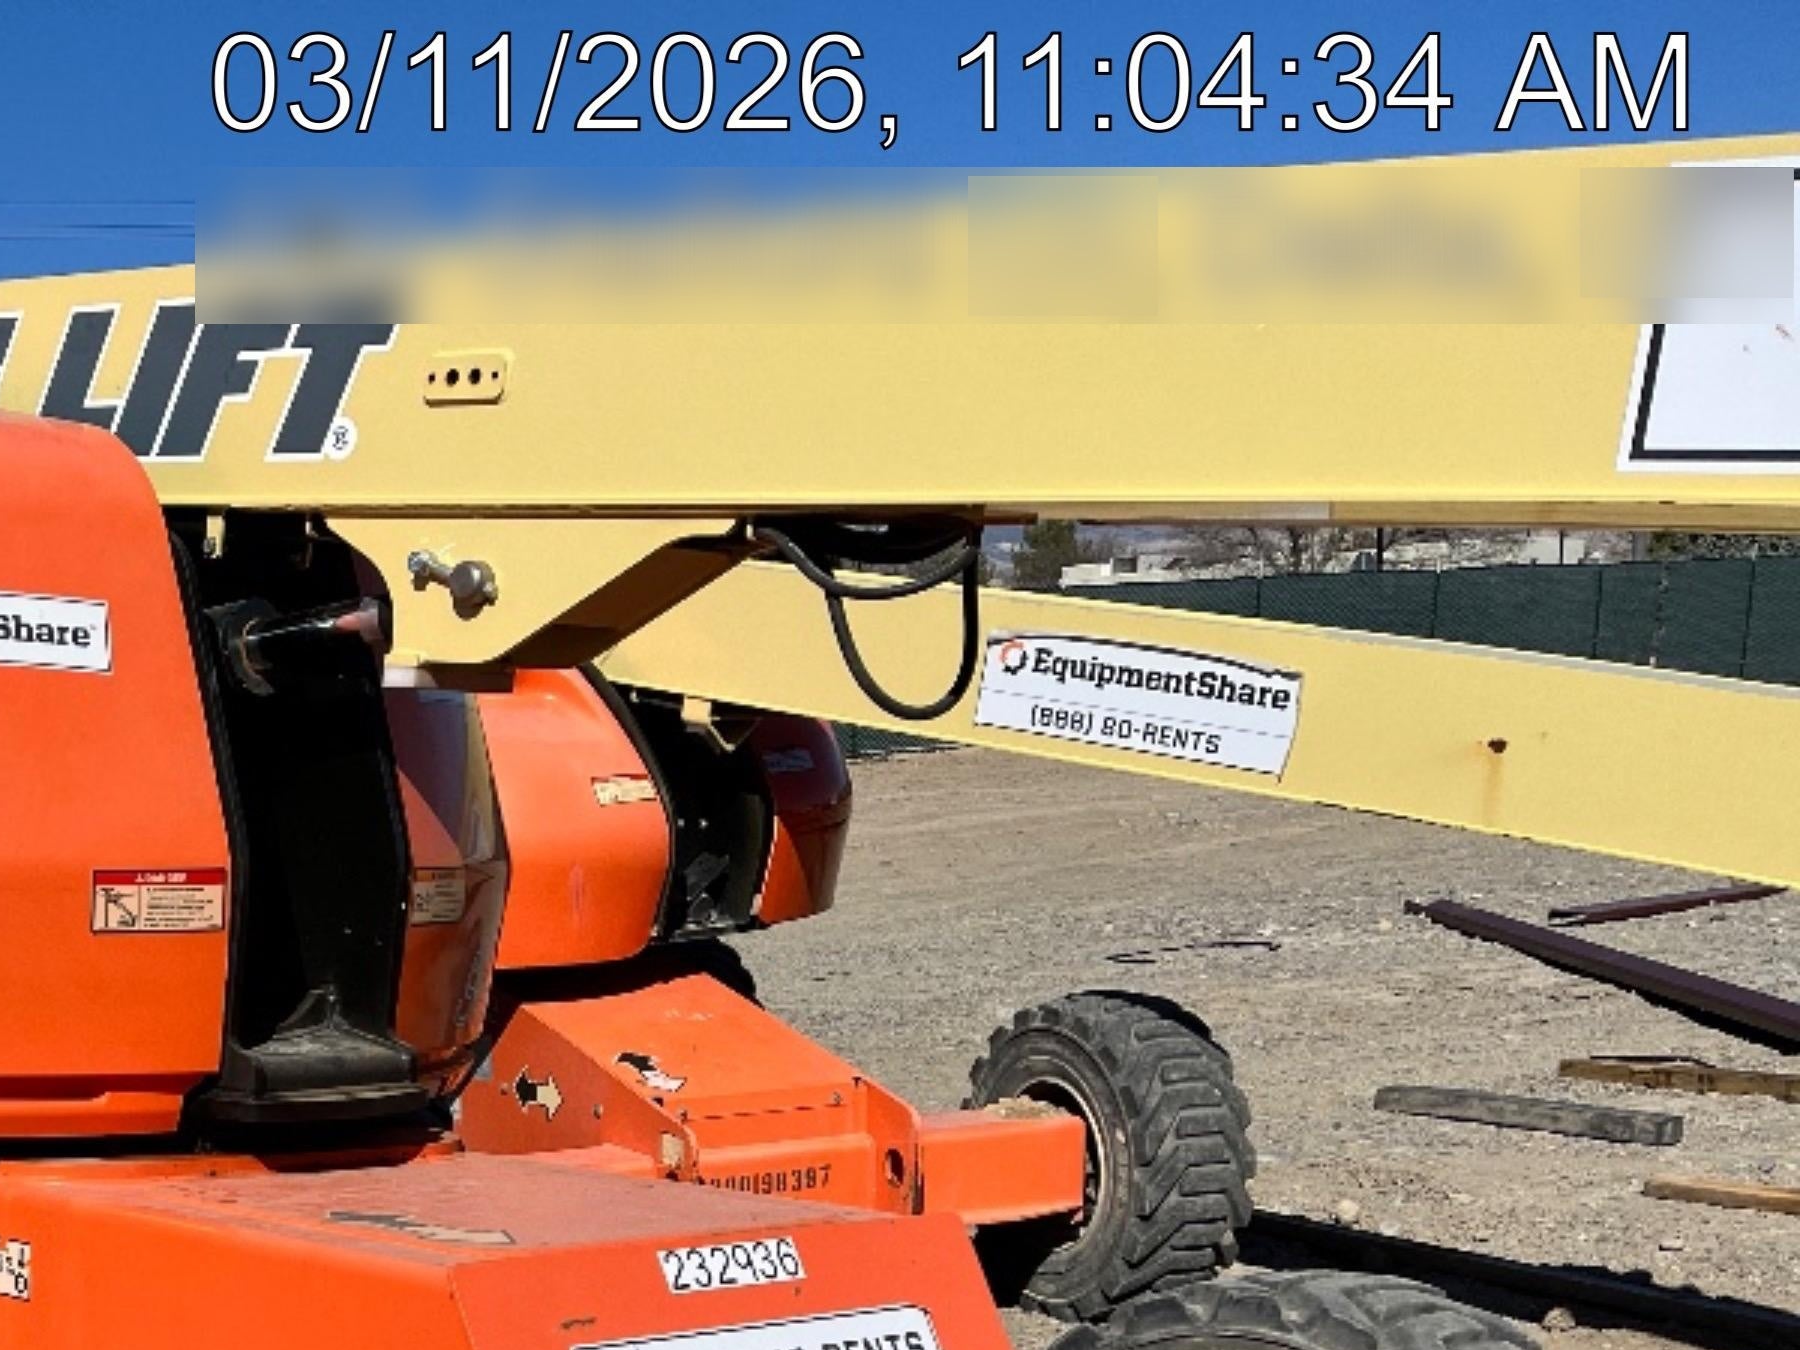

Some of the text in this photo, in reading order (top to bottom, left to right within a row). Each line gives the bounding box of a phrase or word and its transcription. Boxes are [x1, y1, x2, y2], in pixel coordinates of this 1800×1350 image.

[38, 296, 399, 463] LIFT
[1032, 647, 1291, 710] EquipmentShare
[1031, 704, 1221, 755] (888) 80-RENTS
[663, 1239, 800, 1291] 232936
